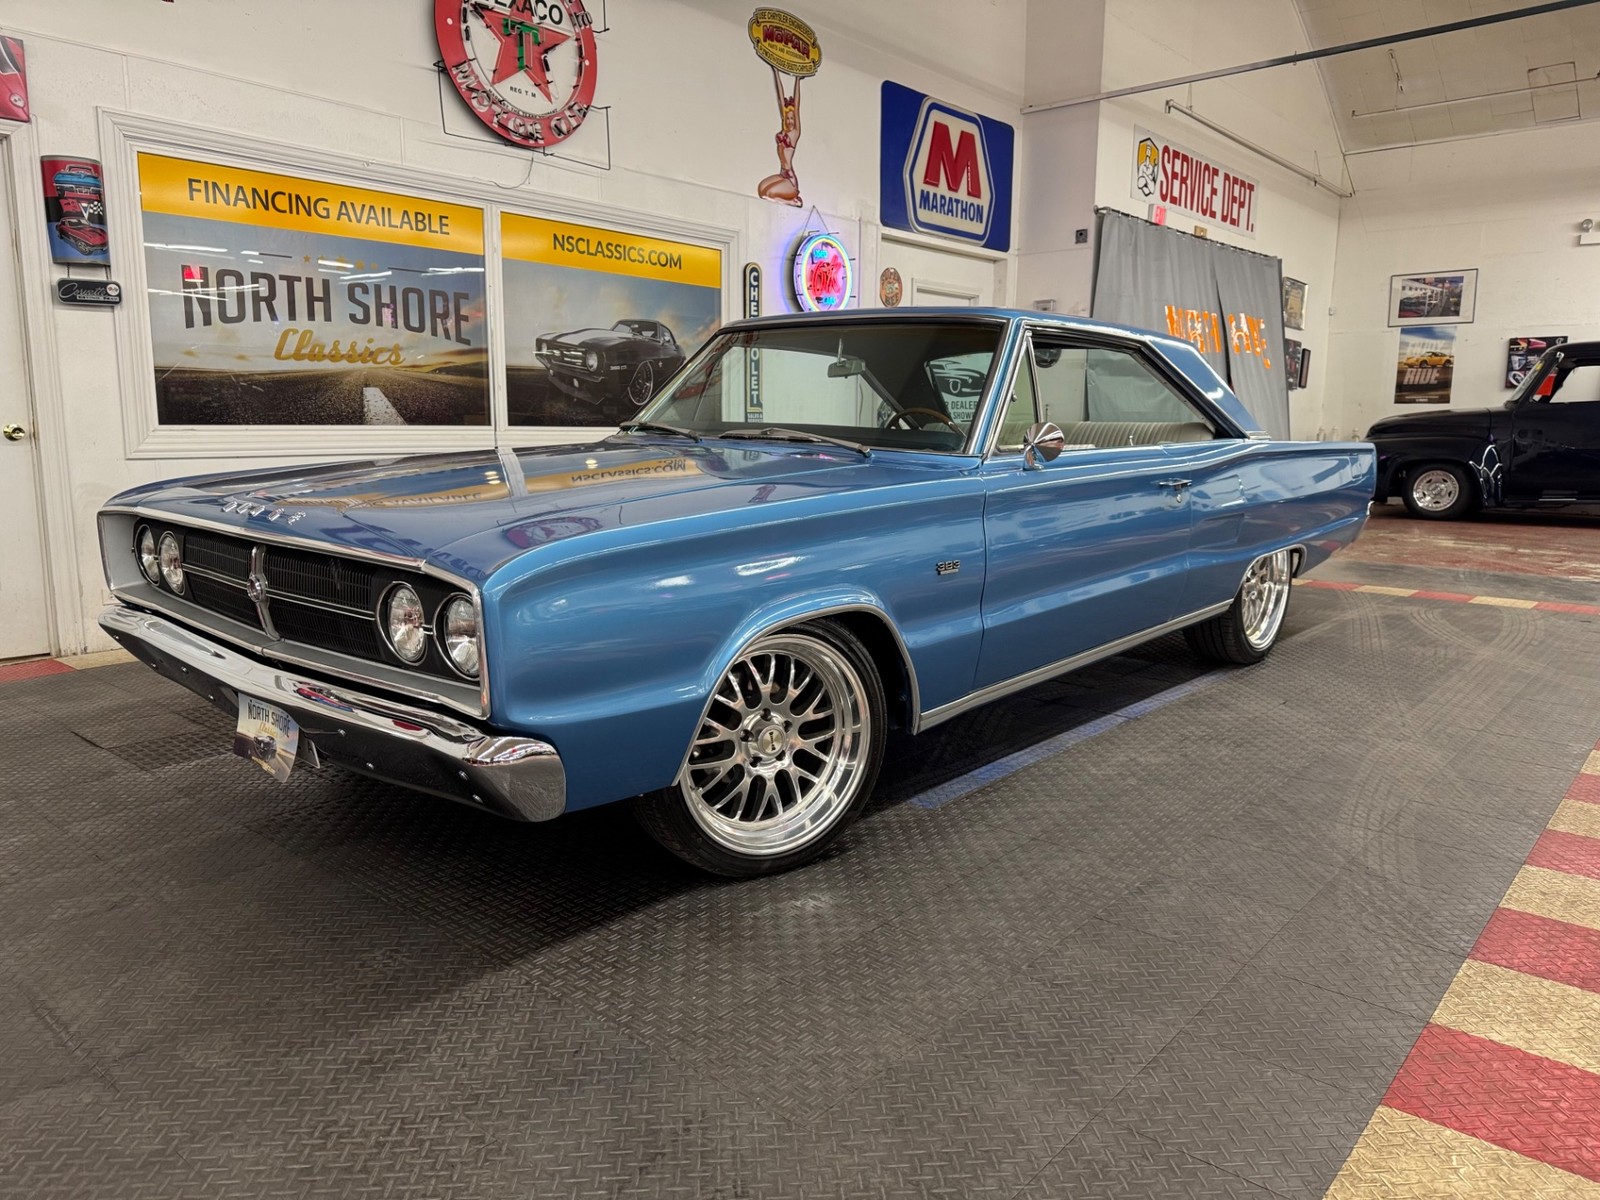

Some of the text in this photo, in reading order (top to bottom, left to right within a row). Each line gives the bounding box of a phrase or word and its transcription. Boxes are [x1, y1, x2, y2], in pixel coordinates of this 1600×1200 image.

[509, 86, 523, 95] REG
[923, 120, 982, 200] M
[187, 177, 451, 236] FINANCING AVAILABLE
[919, 189, 984, 224] MARATHON
[1159, 144, 1255, 233] SERVICE DEPT.
[552, 232, 683, 271] NSCLASSICS.COM
[181, 264, 472, 347] NORTH SHORE
[273, 327, 407, 367] Classics
[749, 271, 760, 405] CHEOLET
[1402, 367, 1441, 385] RIDE
[247, 702, 270, 723] NORTH
